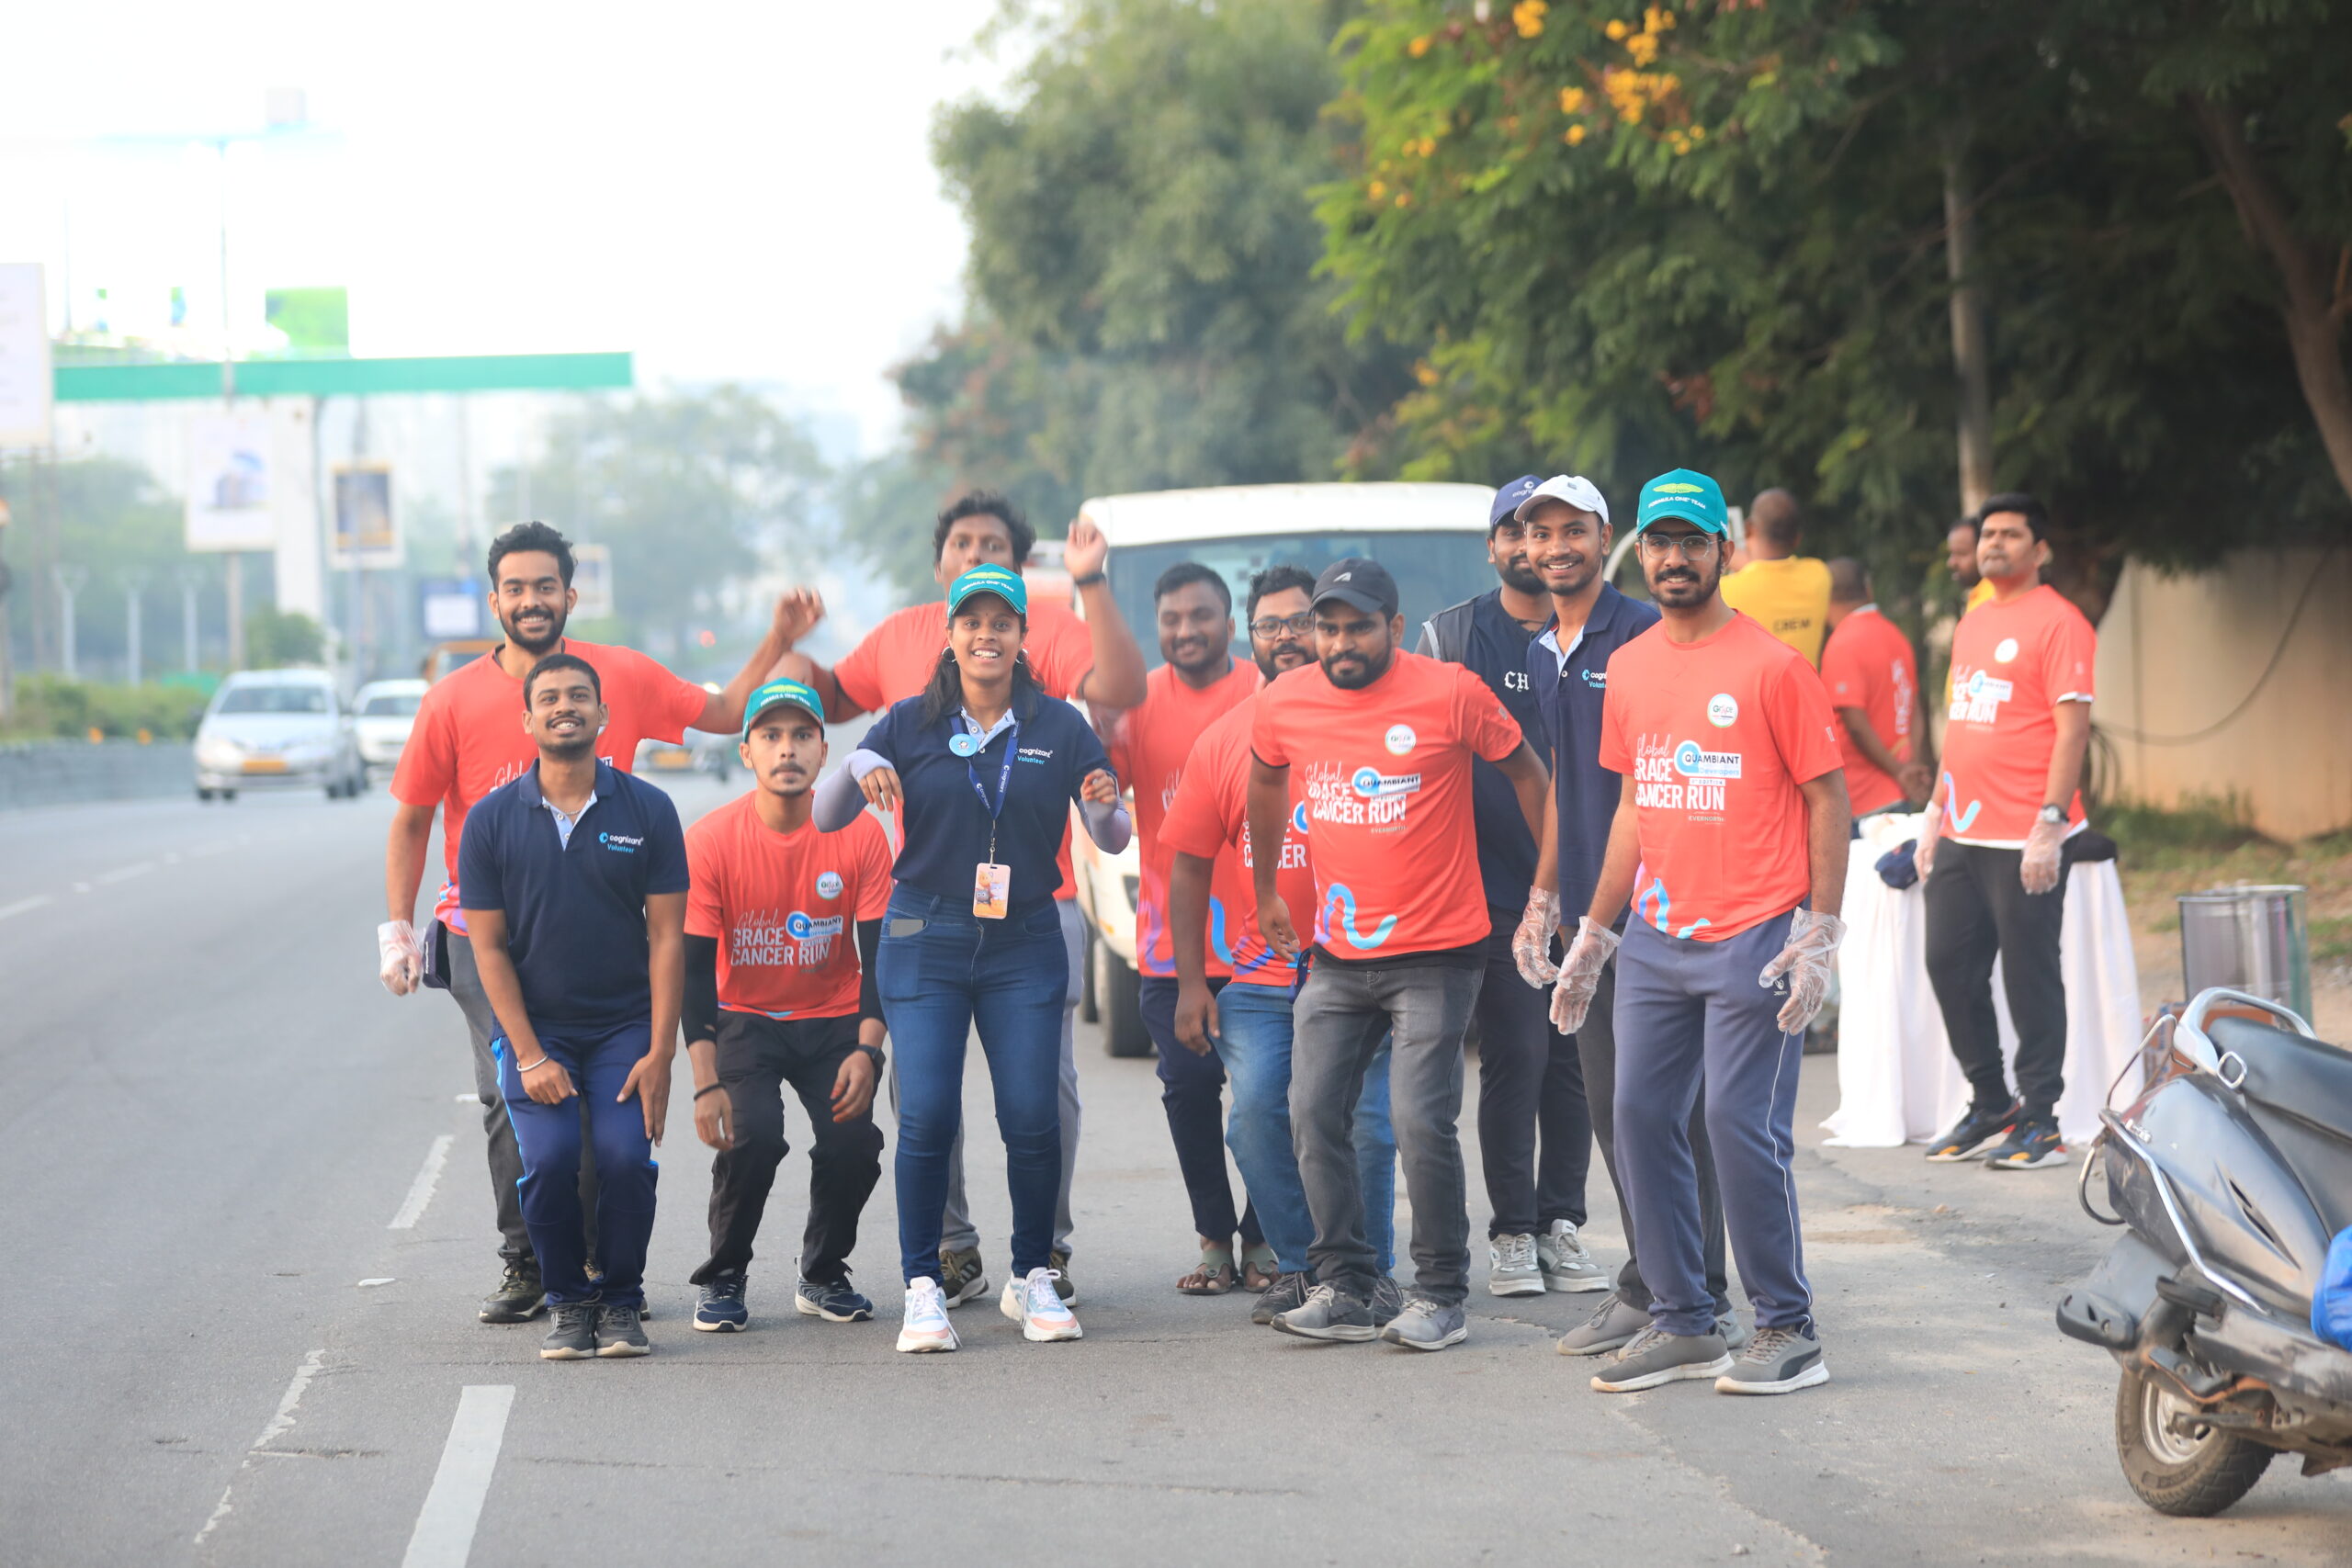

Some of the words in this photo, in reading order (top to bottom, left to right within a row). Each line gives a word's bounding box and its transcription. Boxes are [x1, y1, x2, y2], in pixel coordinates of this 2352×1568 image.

[1648, 496, 1674, 509] FORMULA
[1690, 498, 1706, 510] TEAM
[960, 580, 986, 592] FORMULA
[1001, 582, 1014, 592] TEAM
[1504, 671, 1529, 693] CH
[1017, 755, 1046, 764] Volunteer
[1685, 753, 1740, 764] QUAMBIANT
[1305, 761, 1343, 784] Global
[1363, 774, 1420, 787] QUAMBIANT
[1686, 784, 1725, 811] RUN
[1368, 800, 1407, 824] RUN
[607, 843, 635, 853] Volunteer
[737, 907, 779, 930] Global
[796, 918, 842, 930] QUAMBIANT
[732, 926, 786, 948] GRACE
[731, 945, 795, 966] CANCER
[798, 942, 831, 966] RUN
